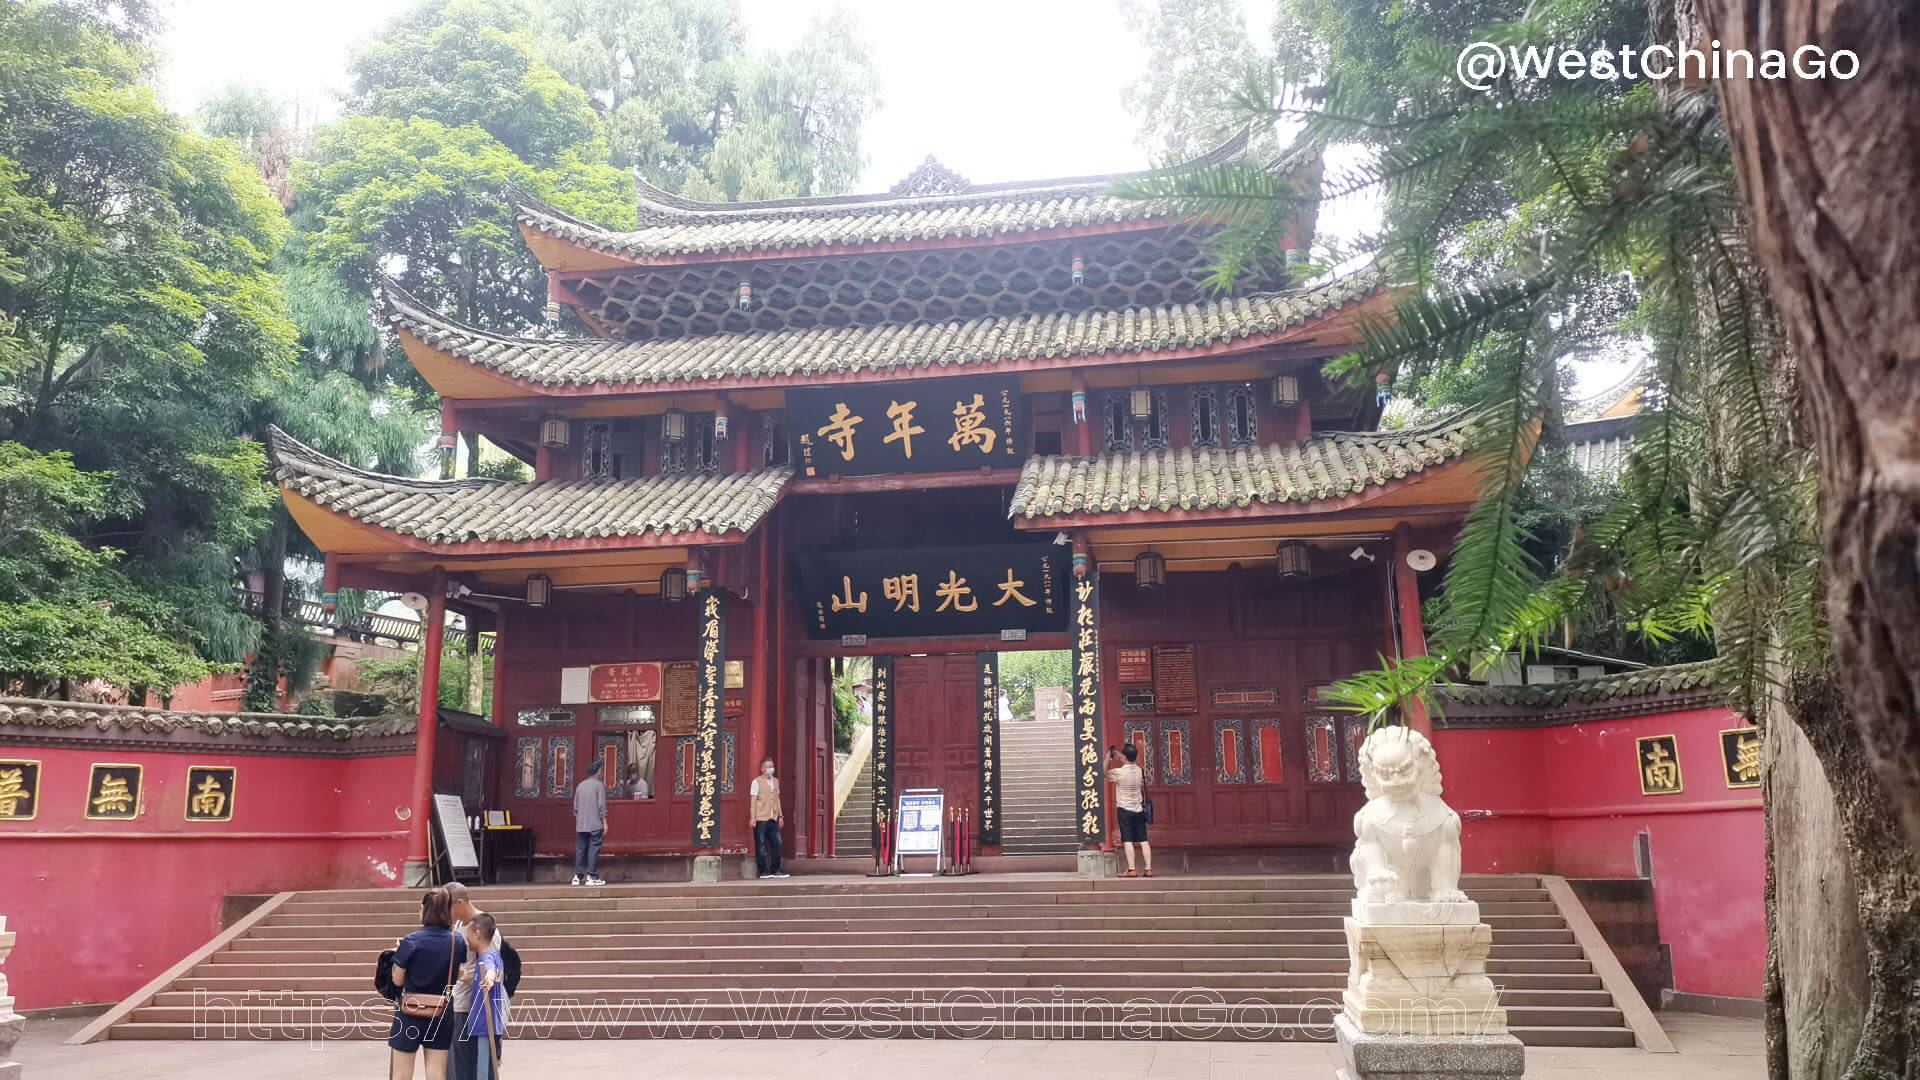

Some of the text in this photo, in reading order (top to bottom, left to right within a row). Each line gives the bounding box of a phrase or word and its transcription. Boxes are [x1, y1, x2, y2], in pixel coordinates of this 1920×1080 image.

[1645, 741, 1677, 789] 南
[92, 773, 134, 813] 無
[192, 774, 226, 816] 南
